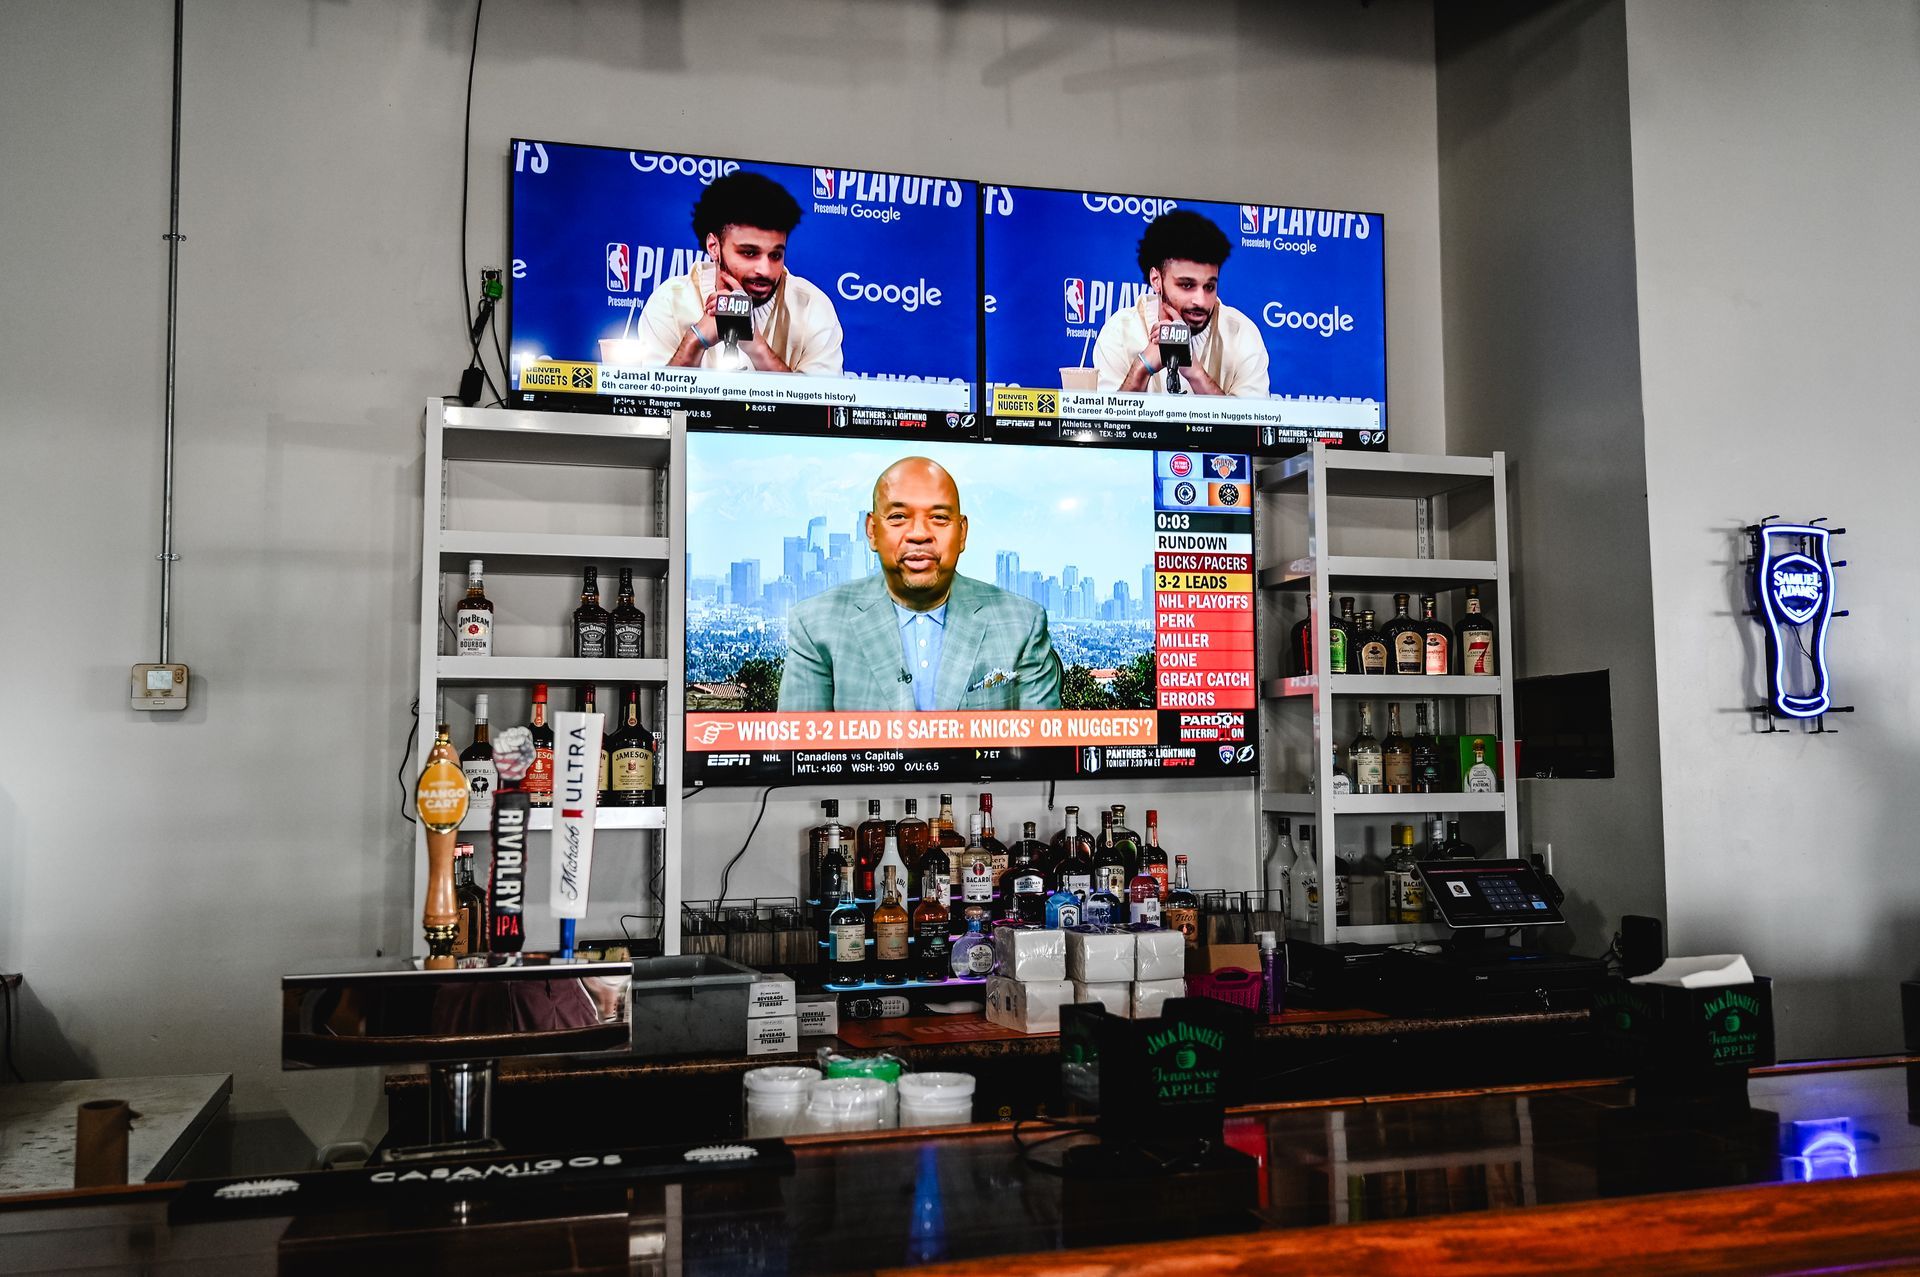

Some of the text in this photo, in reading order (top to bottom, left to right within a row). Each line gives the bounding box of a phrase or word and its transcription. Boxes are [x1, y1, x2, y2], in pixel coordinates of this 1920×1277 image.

[814, 202, 901, 223] Presented by Google
[1241, 237, 1317, 255] Presented by Google
[837, 272, 942, 312] Google
[727, 297, 750, 315] App
[1263, 301, 1354, 337] Google
[1169, 326, 1188, 343] App
[526, 373, 568, 386] NUGGETS
[613, 369, 697, 385] Jamal Murray
[602, 380, 857, 403] 6th career 40-point playoff game (most in Nuggets history)
[649, 398, 681, 408] Rangers
[751, 404, 767, 412] 8:05
[997, 400, 1034, 411] NUGGETS
[1072, 395, 1144, 408] Jamal Murray
[700, 410, 712, 418] 8.5
[852, 410, 927, 421] PANTHERS LIGHTNING
[1062, 406, 1076, 414] 6th
[1104, 407, 1137, 417] 40-point
[1138, 408, 1164, 418] playoff
[1166, 411, 1187, 420] game
[1189, 411, 1211, 420] (most
[1212, 411, 1219, 419] in
[1220, 412, 1252, 422] Nuggets
[1253, 413, 1282, 423] history)
[1062, 421, 1131, 430] Athletics Rangers
[1278, 429, 1344, 439] PANTHERS LIGHTNING
[1157, 513, 1190, 530] 0:03
[1158, 535, 1227, 551] RUNDOWN
[1158, 554, 1247, 571] BUCKS/PACERS
[1158, 574, 1228, 590] 3-2 LEADS
[1773, 571, 1822, 587] SAMUEL
[1779, 585, 1819, 600] ADAMS
[1159, 593, 1249, 609] NHL PLAYOFFS
[1470, 603, 1478, 612] 7
[459, 614, 490, 628] JIM BEAM
[1159, 613, 1195, 628] PERK
[1159, 633, 1209, 648] MILLER
[1160, 652, 1197, 667] CONE
[1468, 641, 1490, 674] 7
[1160, 671, 1250, 687] GREAT CATCH
[1160, 691, 1215, 706] ERRORS
[1180, 715, 1244, 726] PARDON
[737, 717, 1153, 741] WHOSE 3-2 LEAD IS SAFER: KNICKS' OR NUGGETS'?
[615, 750, 650, 761] JAMESON
[707, 754, 781, 766] ESPN NHL
[796, 751, 847, 762] Canadiens
[864, 751, 904, 762] Capitals
[989, 750, 1000, 759] ET
[1105, 748, 1196, 759] PANTHERS LIGHTNING
[565, 726, 587, 803] ULTRA
[797, 762, 939, 773] MTL: +160 WSH: -190 O/U: 6.5
[1105, 759, 1130, 768] TONIGHT
[1130, 759, 1142, 767] 7:30
[1143, 759, 1153, 767] PM
[1154, 758, 1161, 767] ET
[418, 788, 467, 799] MANGO
[425, 798, 459, 809] CART
[495, 809, 524, 910] RIVALRY
[560, 823, 581, 900] Michelob
[496, 915, 519, 936] IPA
[1704, 997, 1724, 1020] JACK
[1147, 1021, 1225, 1055] JACK DANIEL'S
[1713, 1044, 1755, 1058] APPLE
[1152, 1067, 1220, 1083] Tennessee
[1158, 1082, 1217, 1098] APPLE
[370, 1154, 622, 1183] CASAMIGOS
